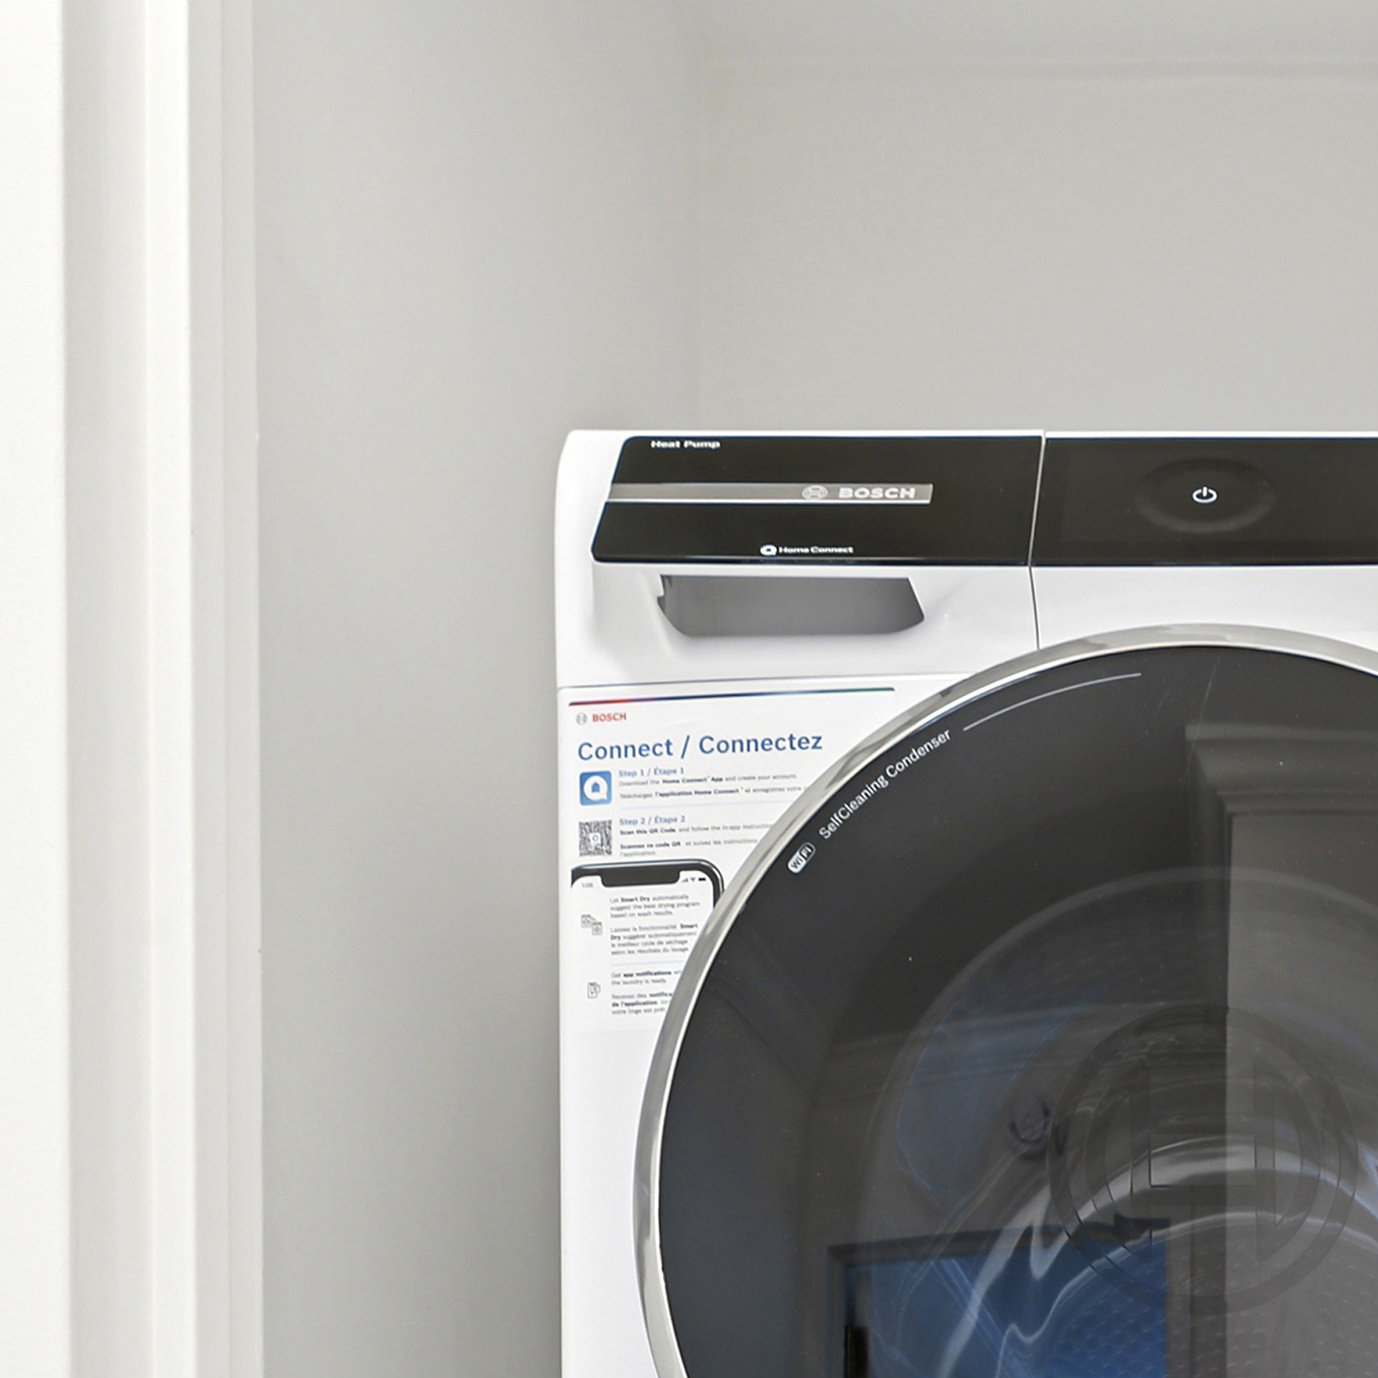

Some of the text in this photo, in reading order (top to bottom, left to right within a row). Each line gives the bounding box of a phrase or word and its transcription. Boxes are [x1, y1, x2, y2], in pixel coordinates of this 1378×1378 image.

[839, 487, 915, 499] BOSCH
[592, 713, 627, 722] BOSCH
[578, 736, 822, 760] Connect / Connectez
[819, 730, 952, 839] SelfCleaning Condenser
